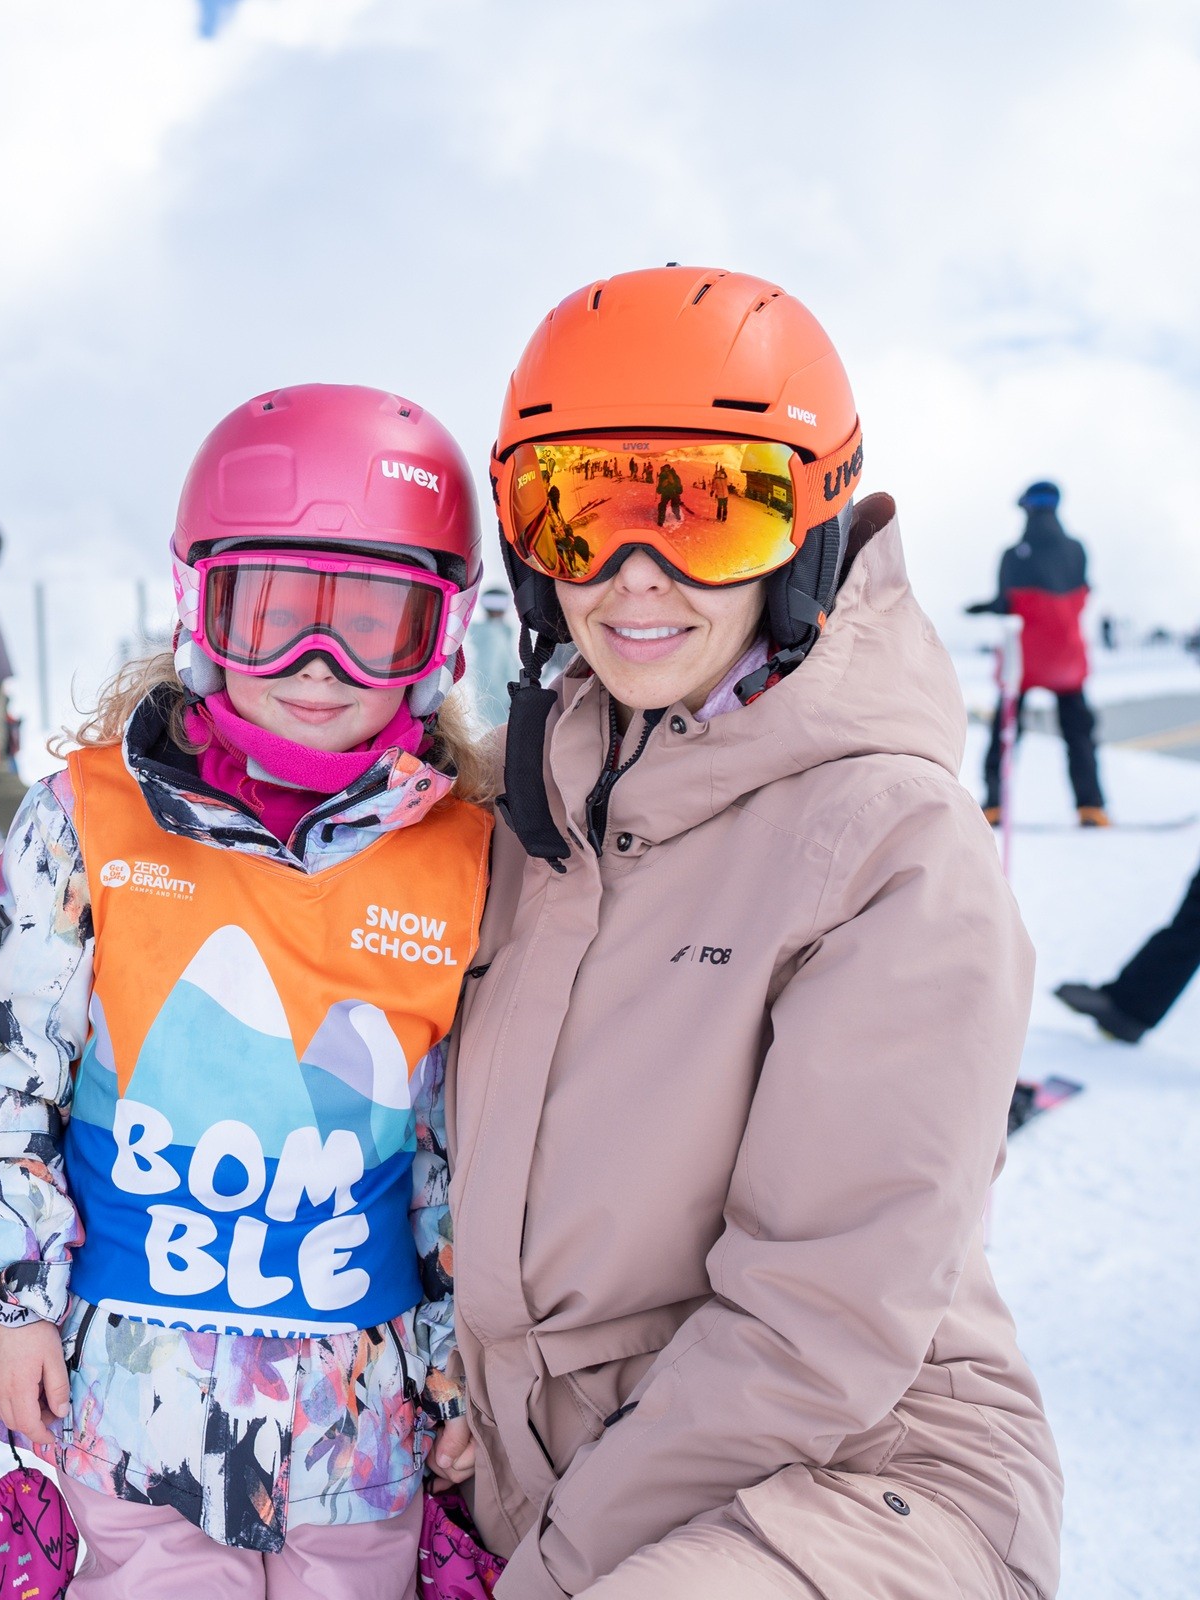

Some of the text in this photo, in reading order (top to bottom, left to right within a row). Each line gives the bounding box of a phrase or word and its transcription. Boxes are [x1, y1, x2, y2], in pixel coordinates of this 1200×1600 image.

[787, 405, 817, 427] uvex
[381, 460, 440, 493] uvex
[823, 442, 864, 502] uve
[131, 873, 196, 894] GRAVITY
[133, 861, 170, 877] ZERO
[129, 886, 153, 895] CAMPS
[173, 893, 193, 901] TRIPS
[366, 904, 447, 941] SNOW
[351, 928, 458, 966] SCHOOL
[111, 1098, 365, 1223] BOM
[145, 1204, 372, 1312] BLE
